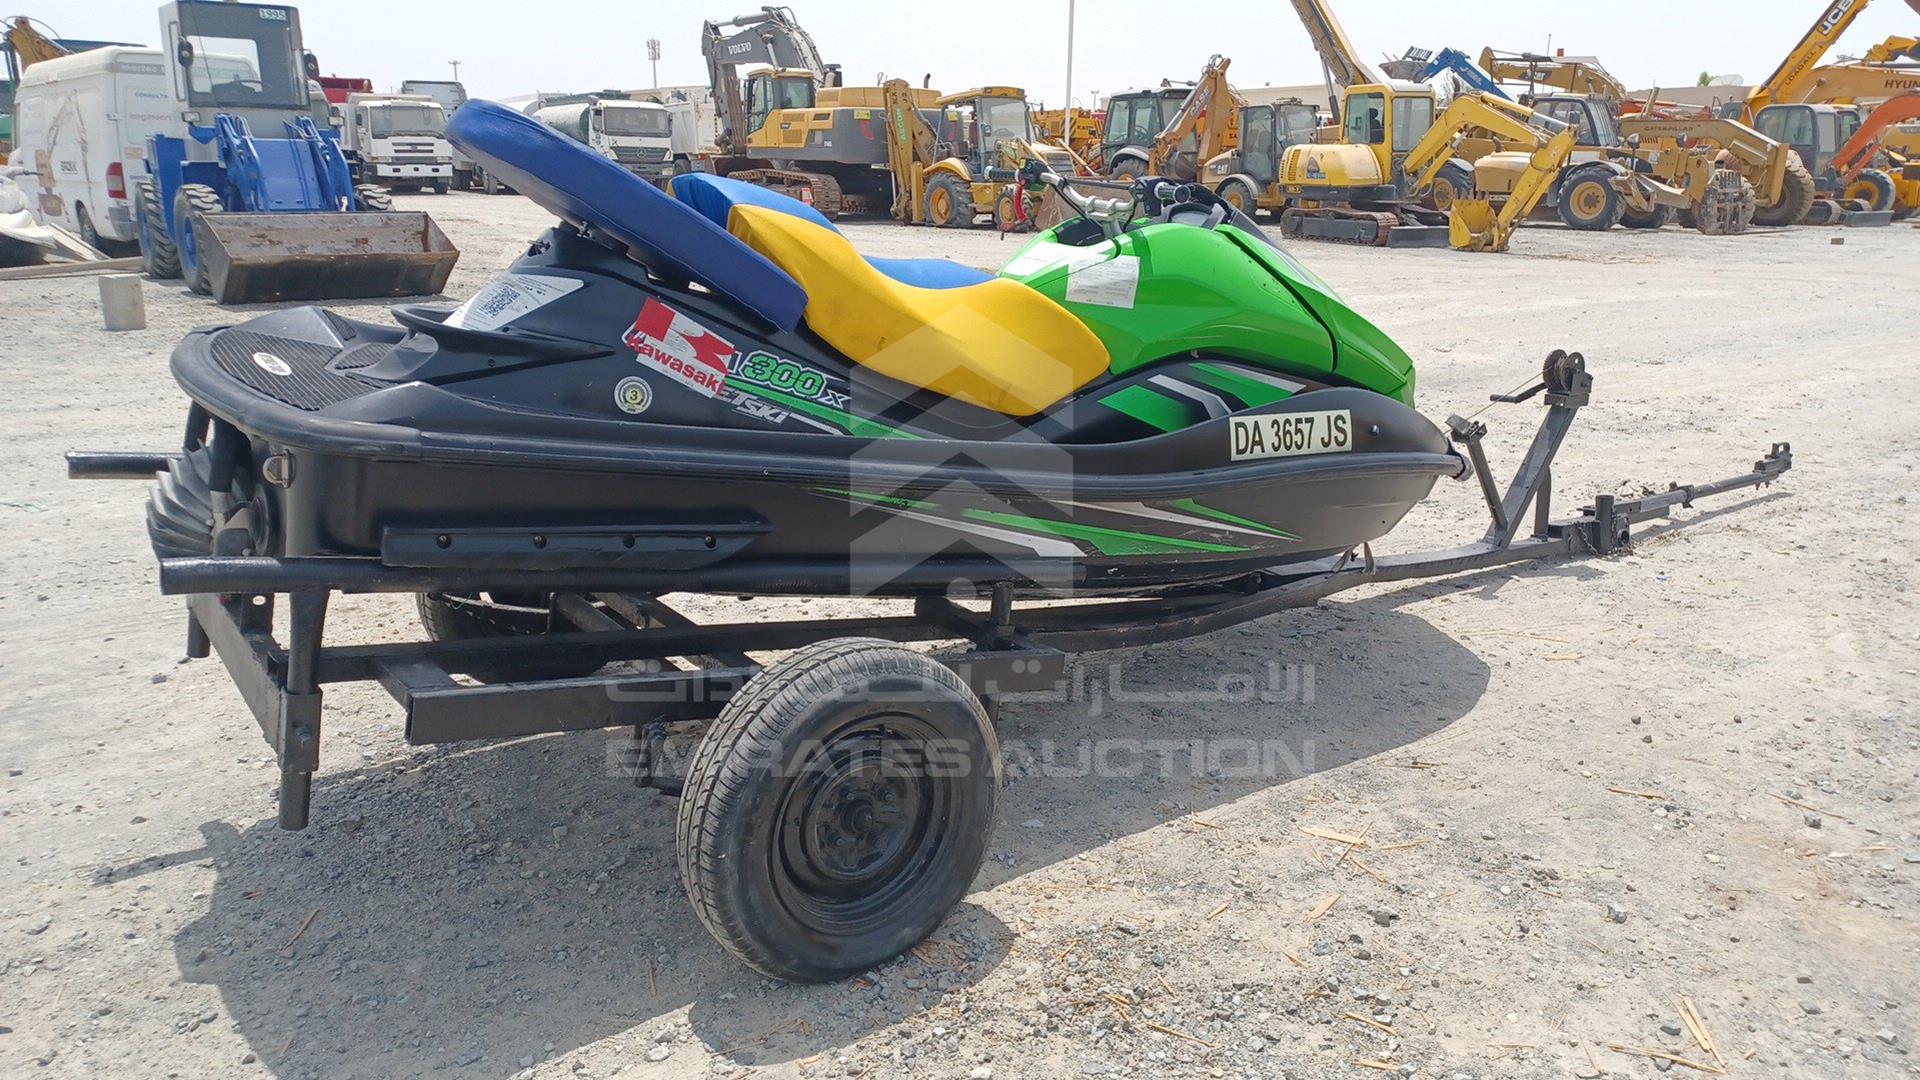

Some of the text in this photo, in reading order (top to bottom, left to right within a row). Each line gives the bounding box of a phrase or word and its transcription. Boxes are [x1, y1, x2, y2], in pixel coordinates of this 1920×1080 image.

[1822, 0, 1855, 35] JCB
[728, 41, 751, 55] VOLVO
[626, 334, 725, 396] Kawasaki
[630, 390, 638, 401] 3
[1234, 414, 1348, 455] DA 3657 JS
